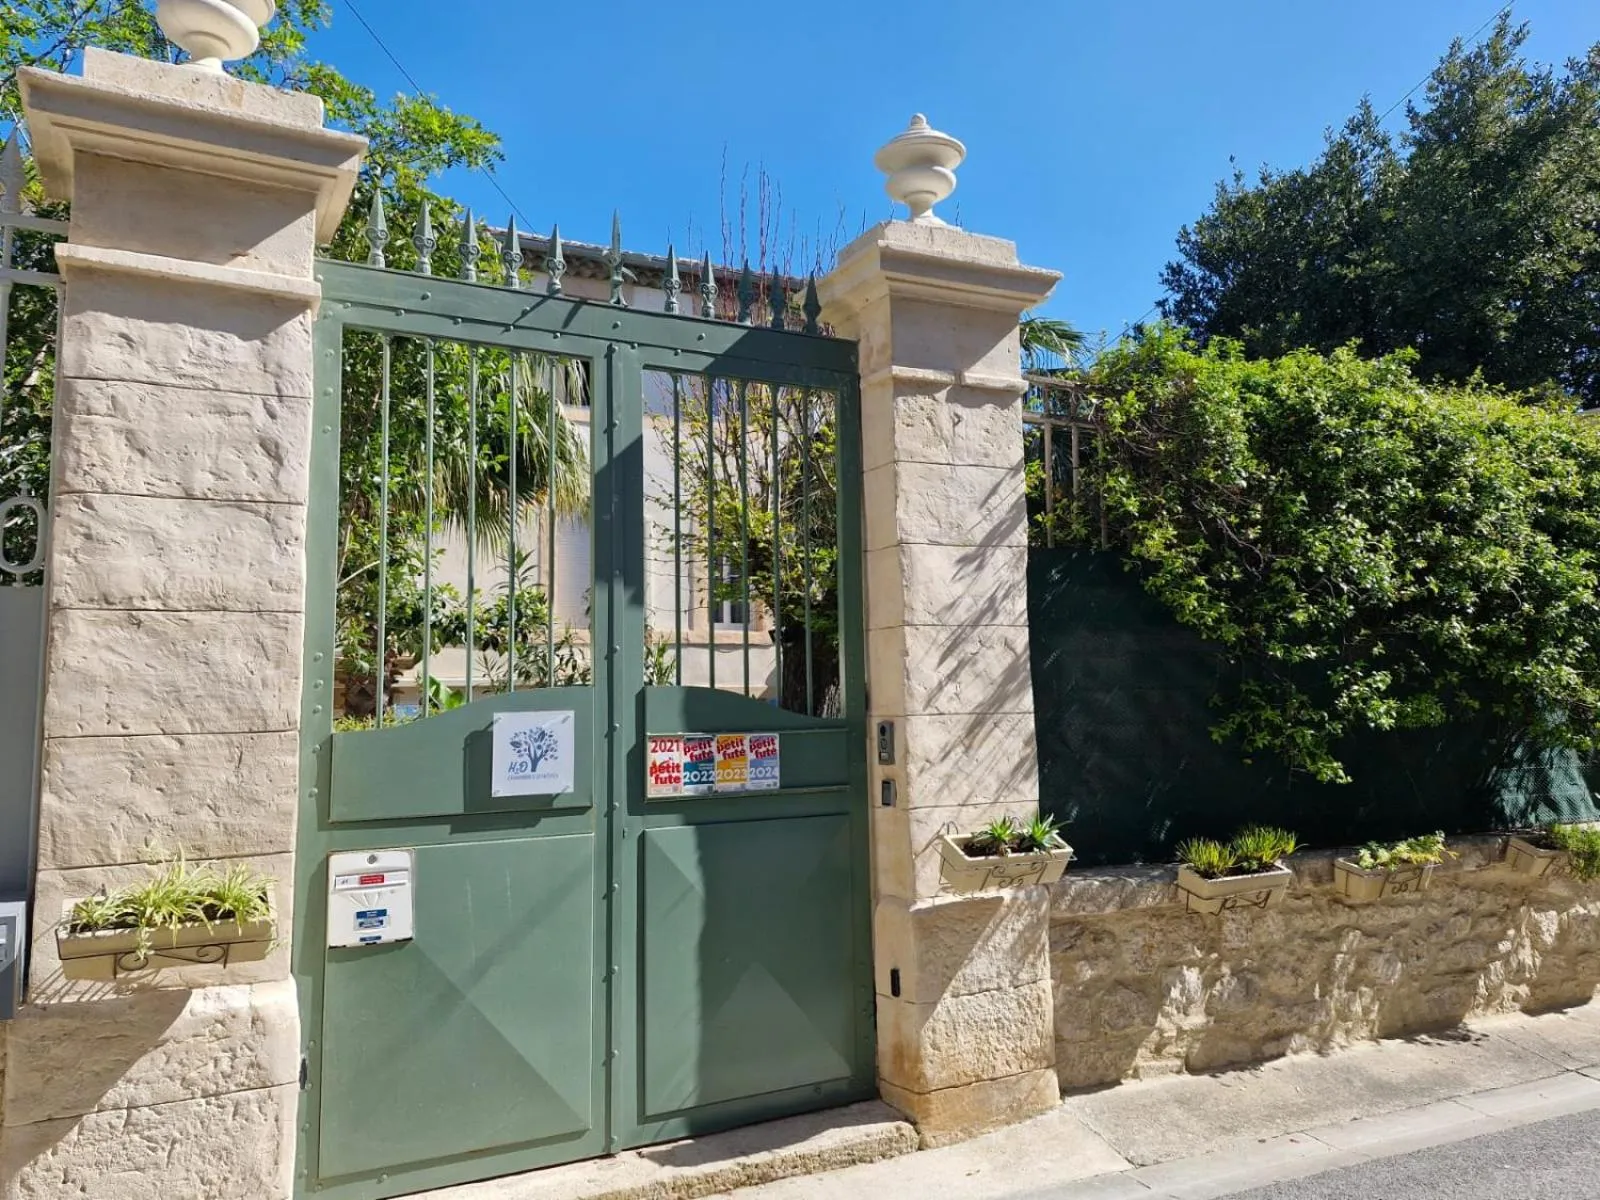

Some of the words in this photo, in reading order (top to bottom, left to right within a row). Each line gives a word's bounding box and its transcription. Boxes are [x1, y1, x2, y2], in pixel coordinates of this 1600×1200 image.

[651, 739, 681, 753] 2021
[684, 740, 712, 755] petit
[717, 737, 744, 754] petit
[750, 736, 776, 753] petit
[649, 762, 681, 777] petit
[684, 770, 715, 783] 2022
